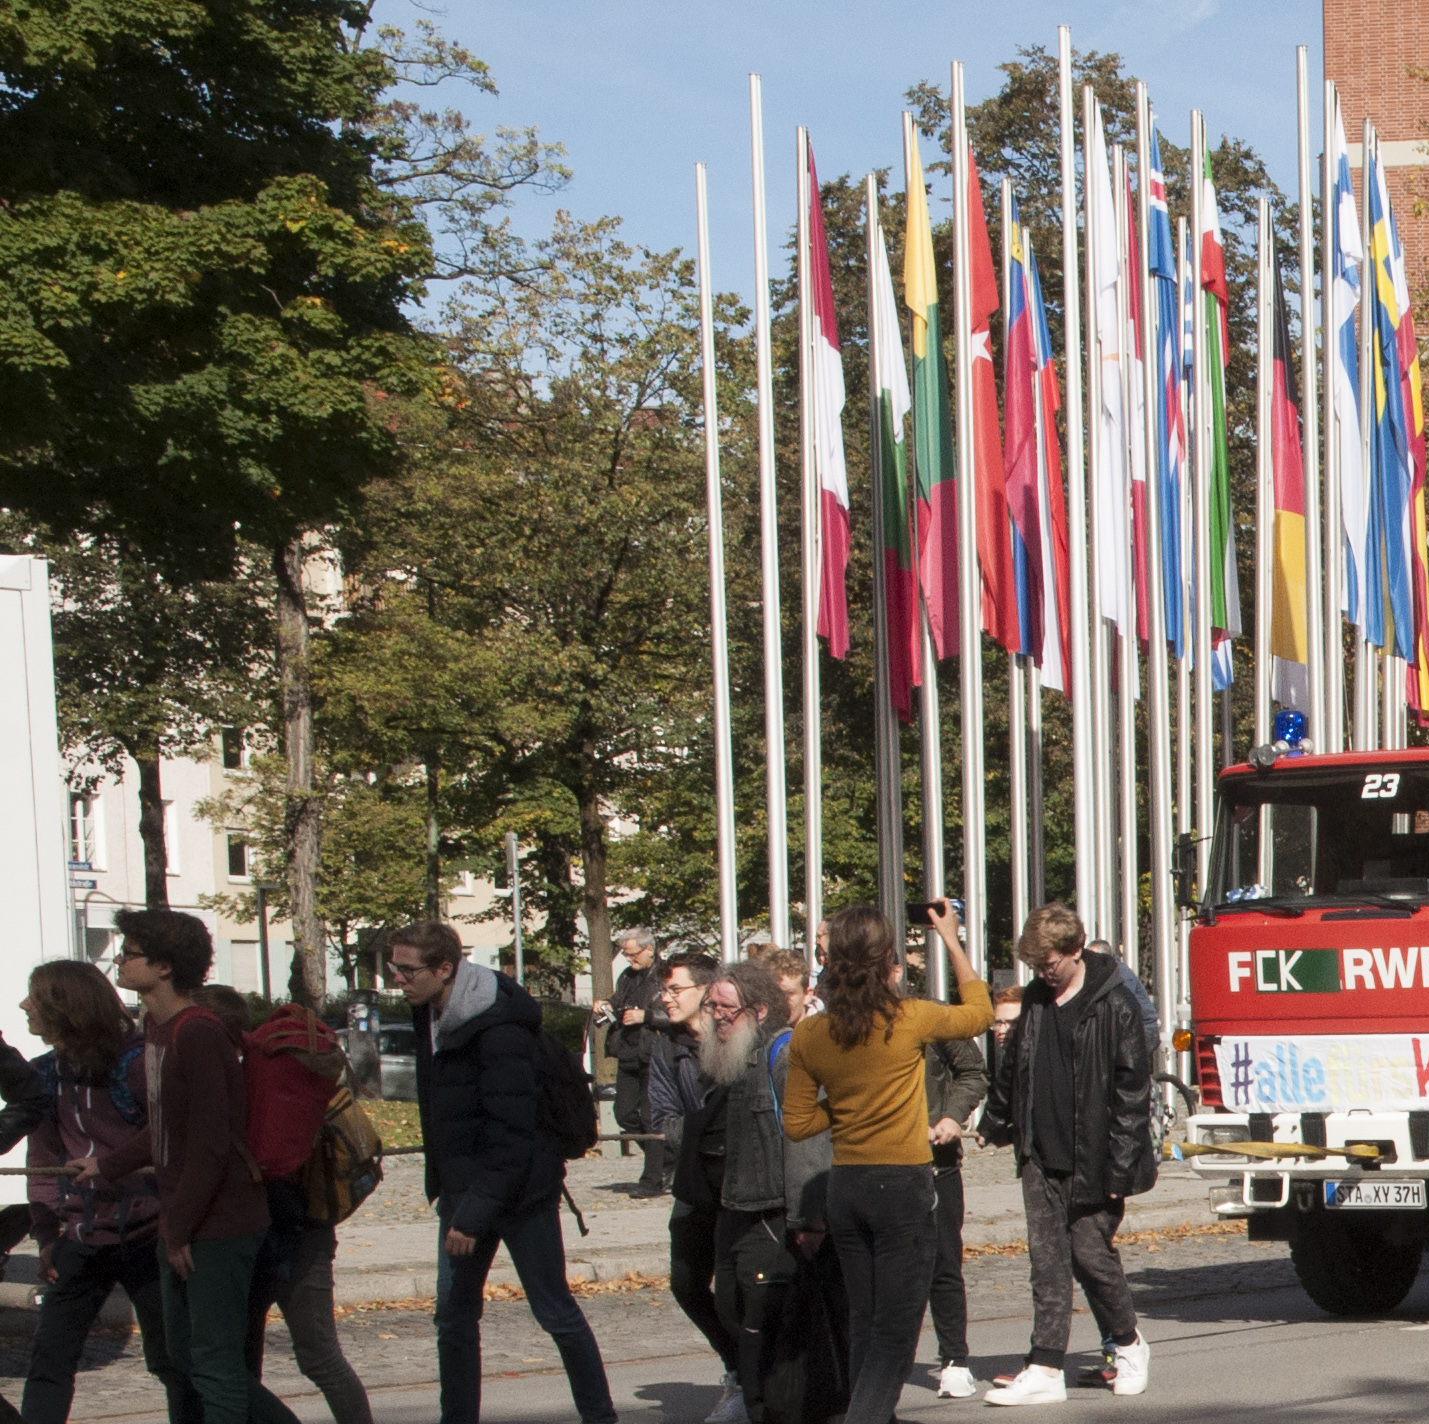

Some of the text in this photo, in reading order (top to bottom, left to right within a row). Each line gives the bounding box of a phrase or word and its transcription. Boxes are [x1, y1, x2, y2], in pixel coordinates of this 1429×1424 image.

[1361, 773, 1400, 798] 23
[1228, 949, 1303, 992] FCK
[1336, 1186, 1421, 1203] STA XY 37H
